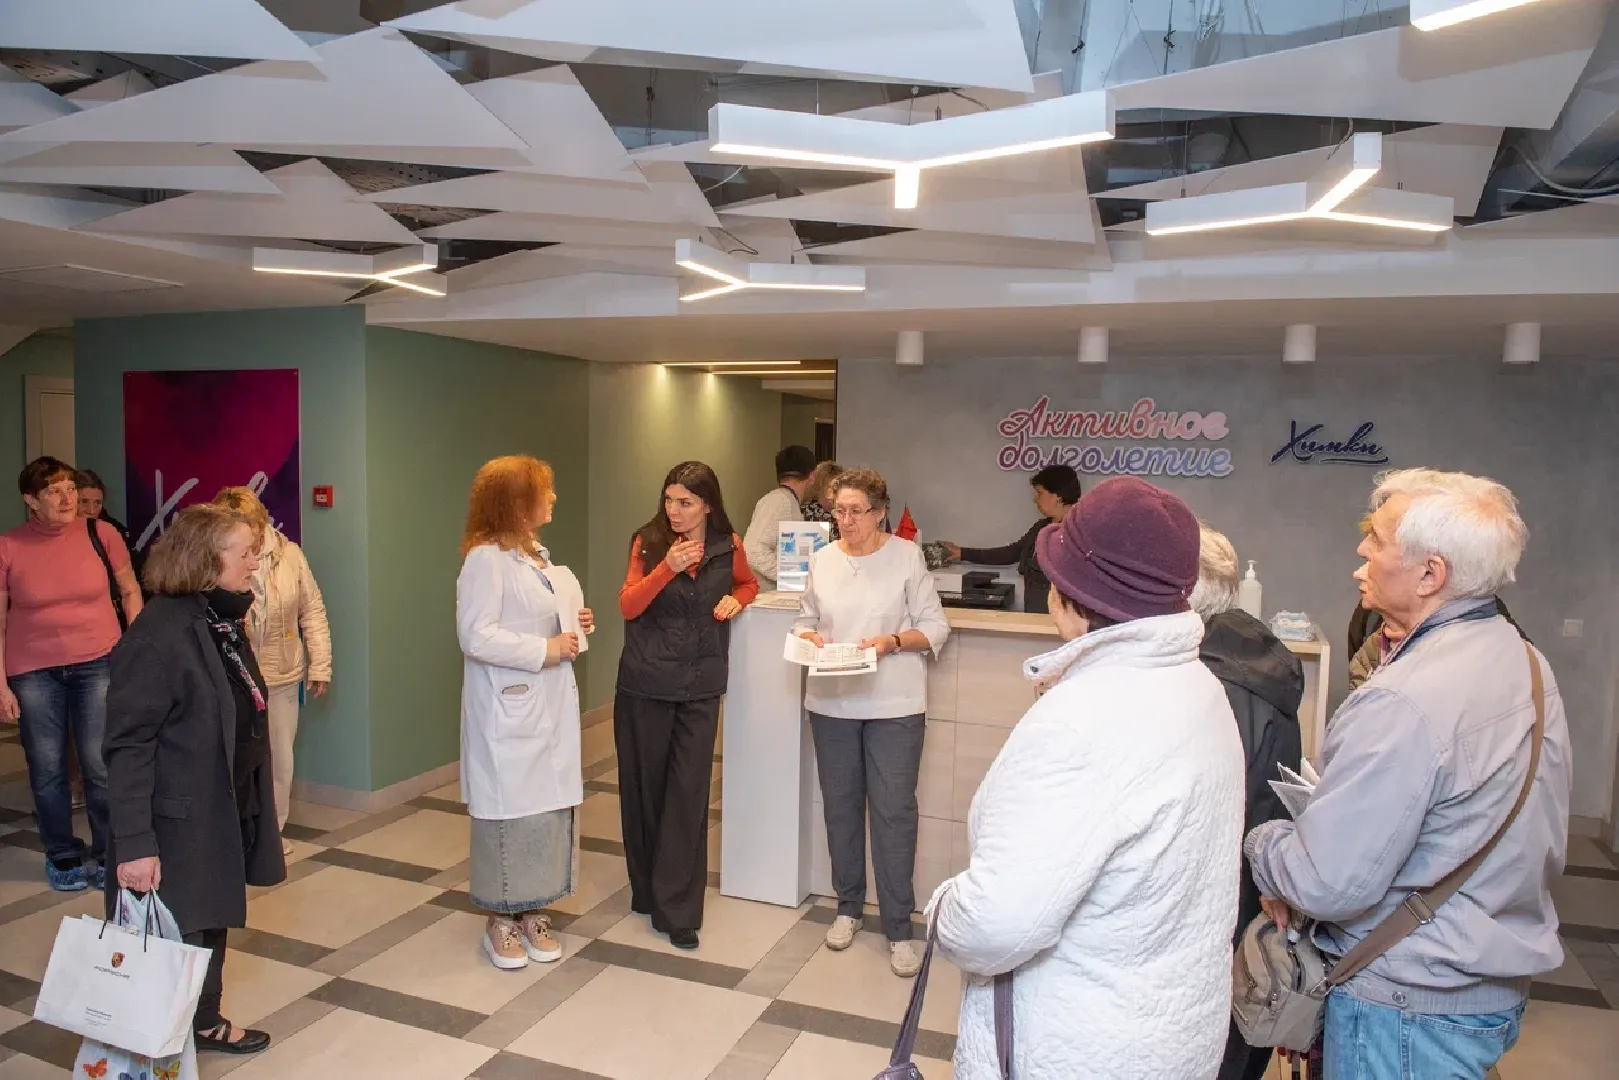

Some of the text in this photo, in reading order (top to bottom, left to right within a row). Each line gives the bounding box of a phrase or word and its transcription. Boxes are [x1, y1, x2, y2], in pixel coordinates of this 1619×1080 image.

[998, 396, 1229, 440] Активное
[997, 429, 1234, 476] долголетие
[1271, 419, 1384, 462] Химки
